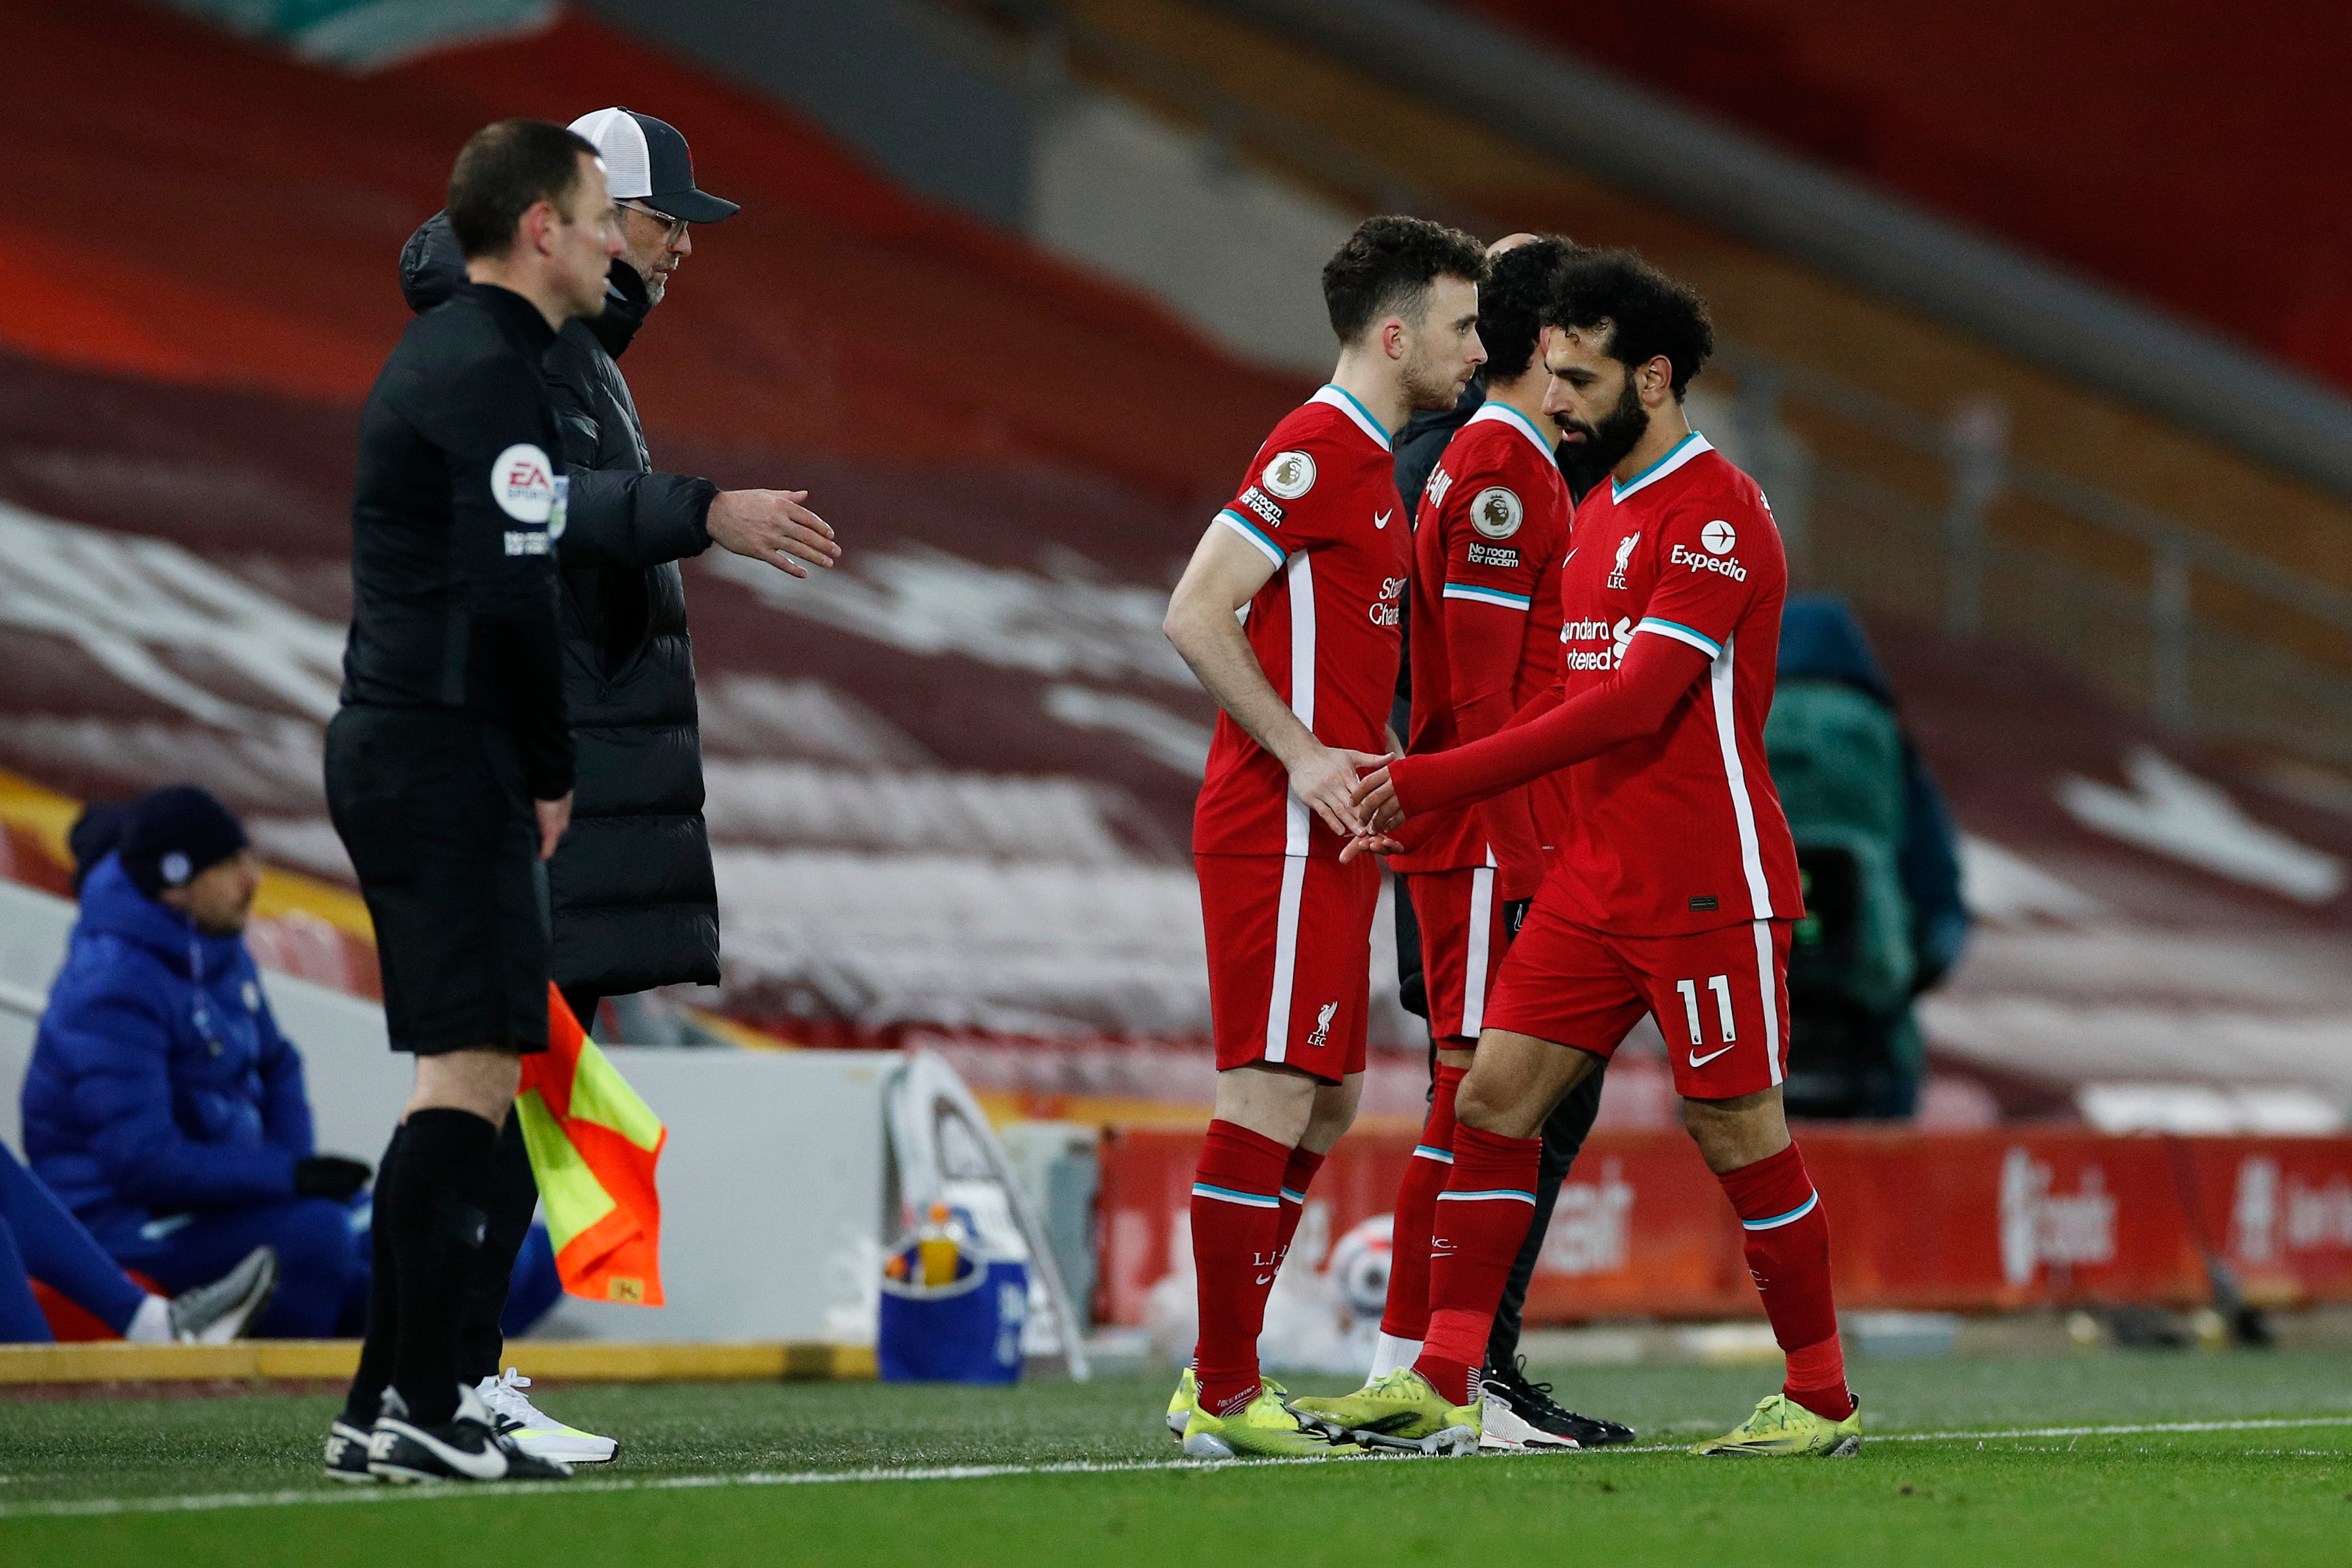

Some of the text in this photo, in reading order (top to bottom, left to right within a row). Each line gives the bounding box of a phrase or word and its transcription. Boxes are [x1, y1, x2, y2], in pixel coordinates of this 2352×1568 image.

[510, 462, 549, 488] EA
[1249, 501, 1280, 528] racism
[1255, 494, 1282, 518] room
[1468, 552, 1519, 568] for racism
[1470, 543, 1515, 559] No room
[1670, 544, 1747, 582] Expedia
[1676, 974, 1737, 1045] 11
